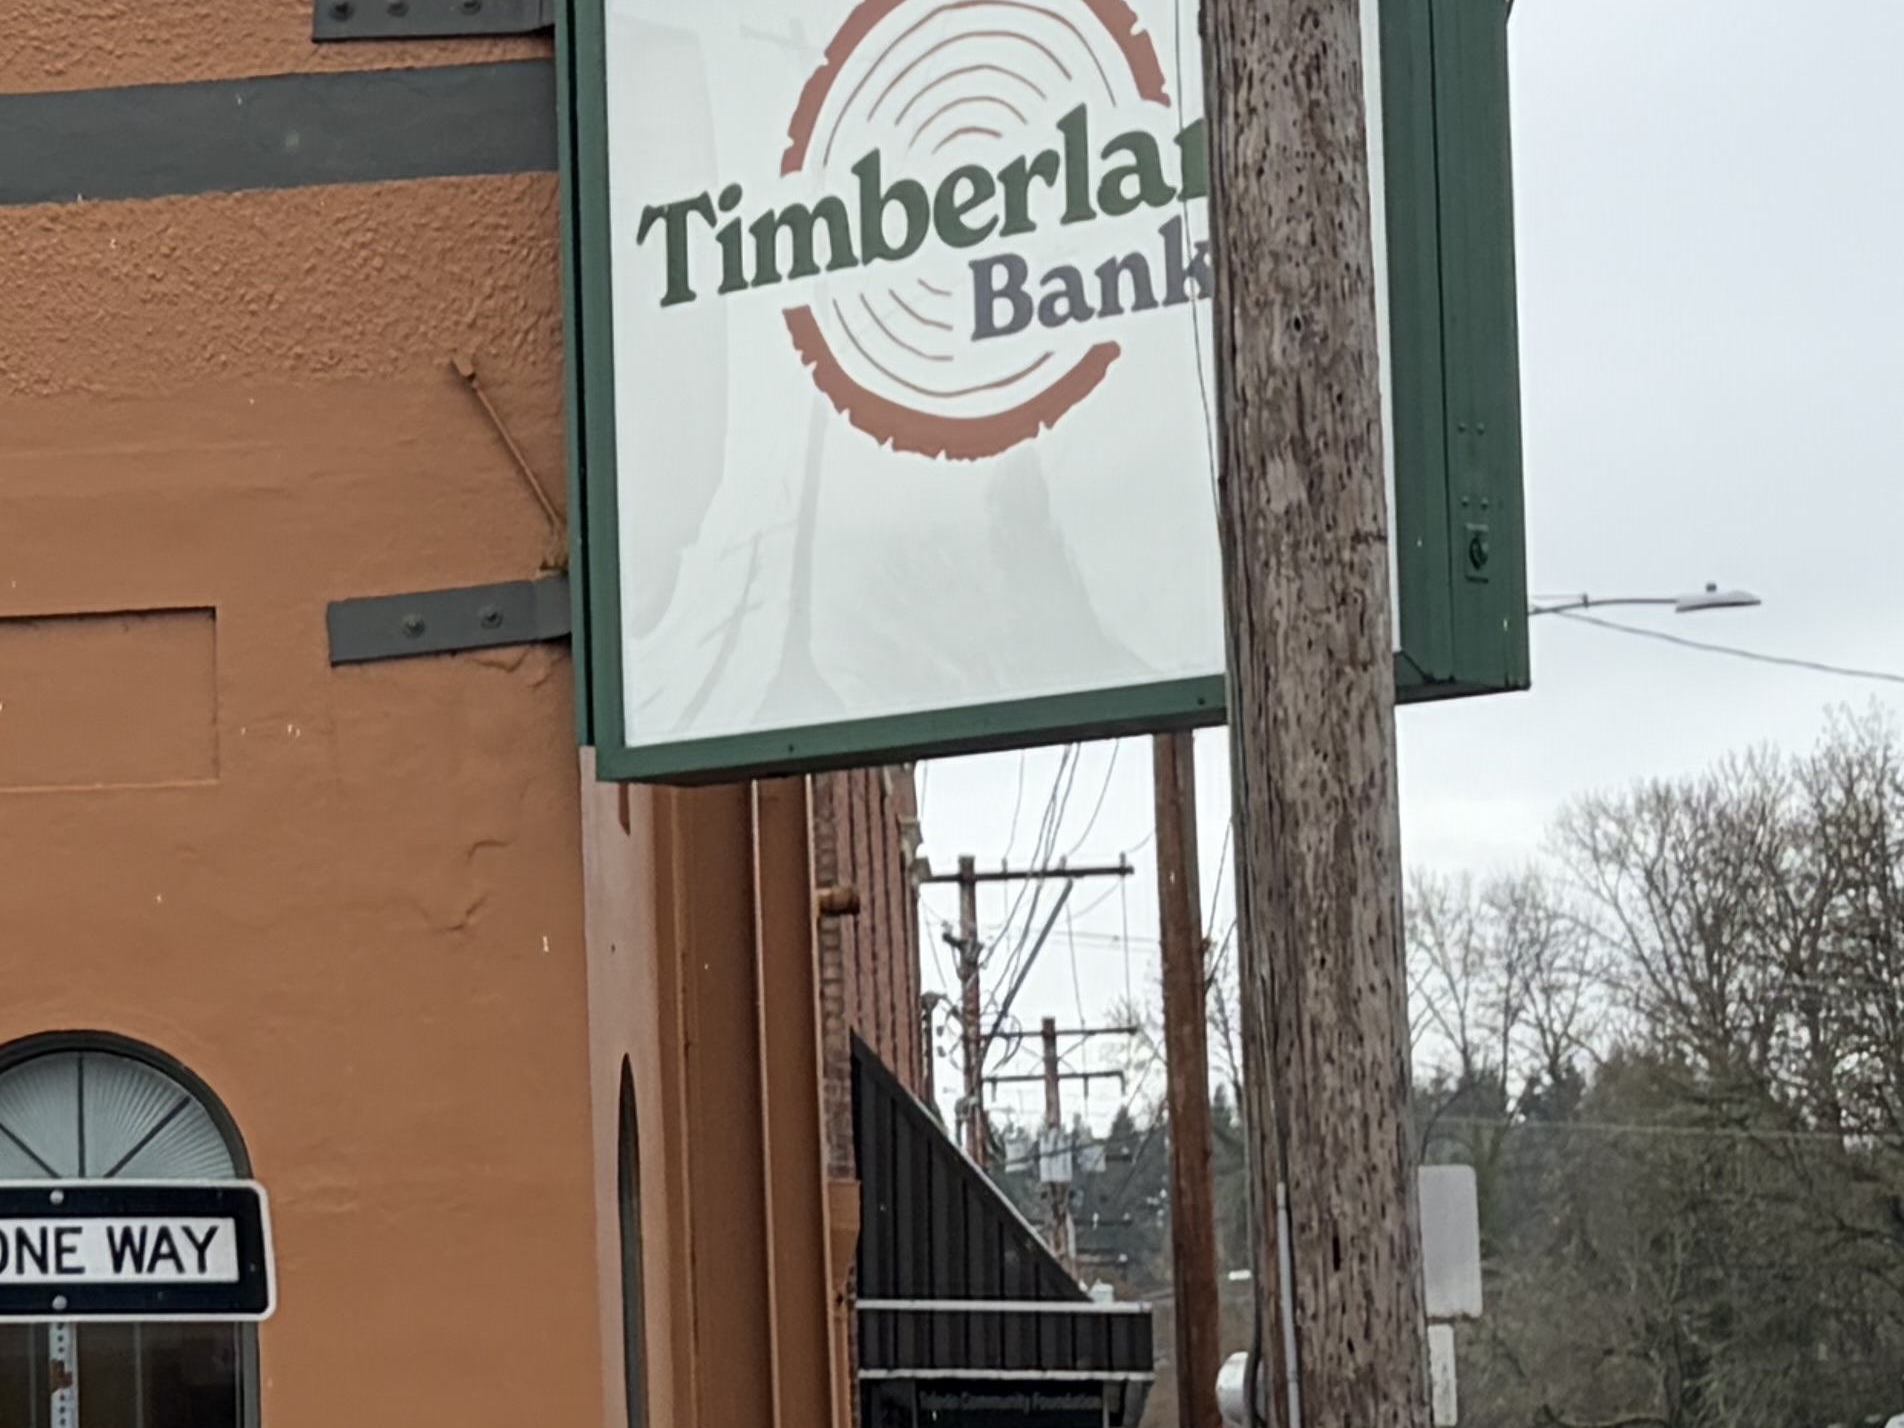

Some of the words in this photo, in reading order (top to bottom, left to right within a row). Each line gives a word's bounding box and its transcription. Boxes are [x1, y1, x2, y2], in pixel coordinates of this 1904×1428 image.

[635, 102, 1208, 308] Timberla
[970, 215, 1212, 341] Bank
[105, 1224, 220, 1275] WAY
